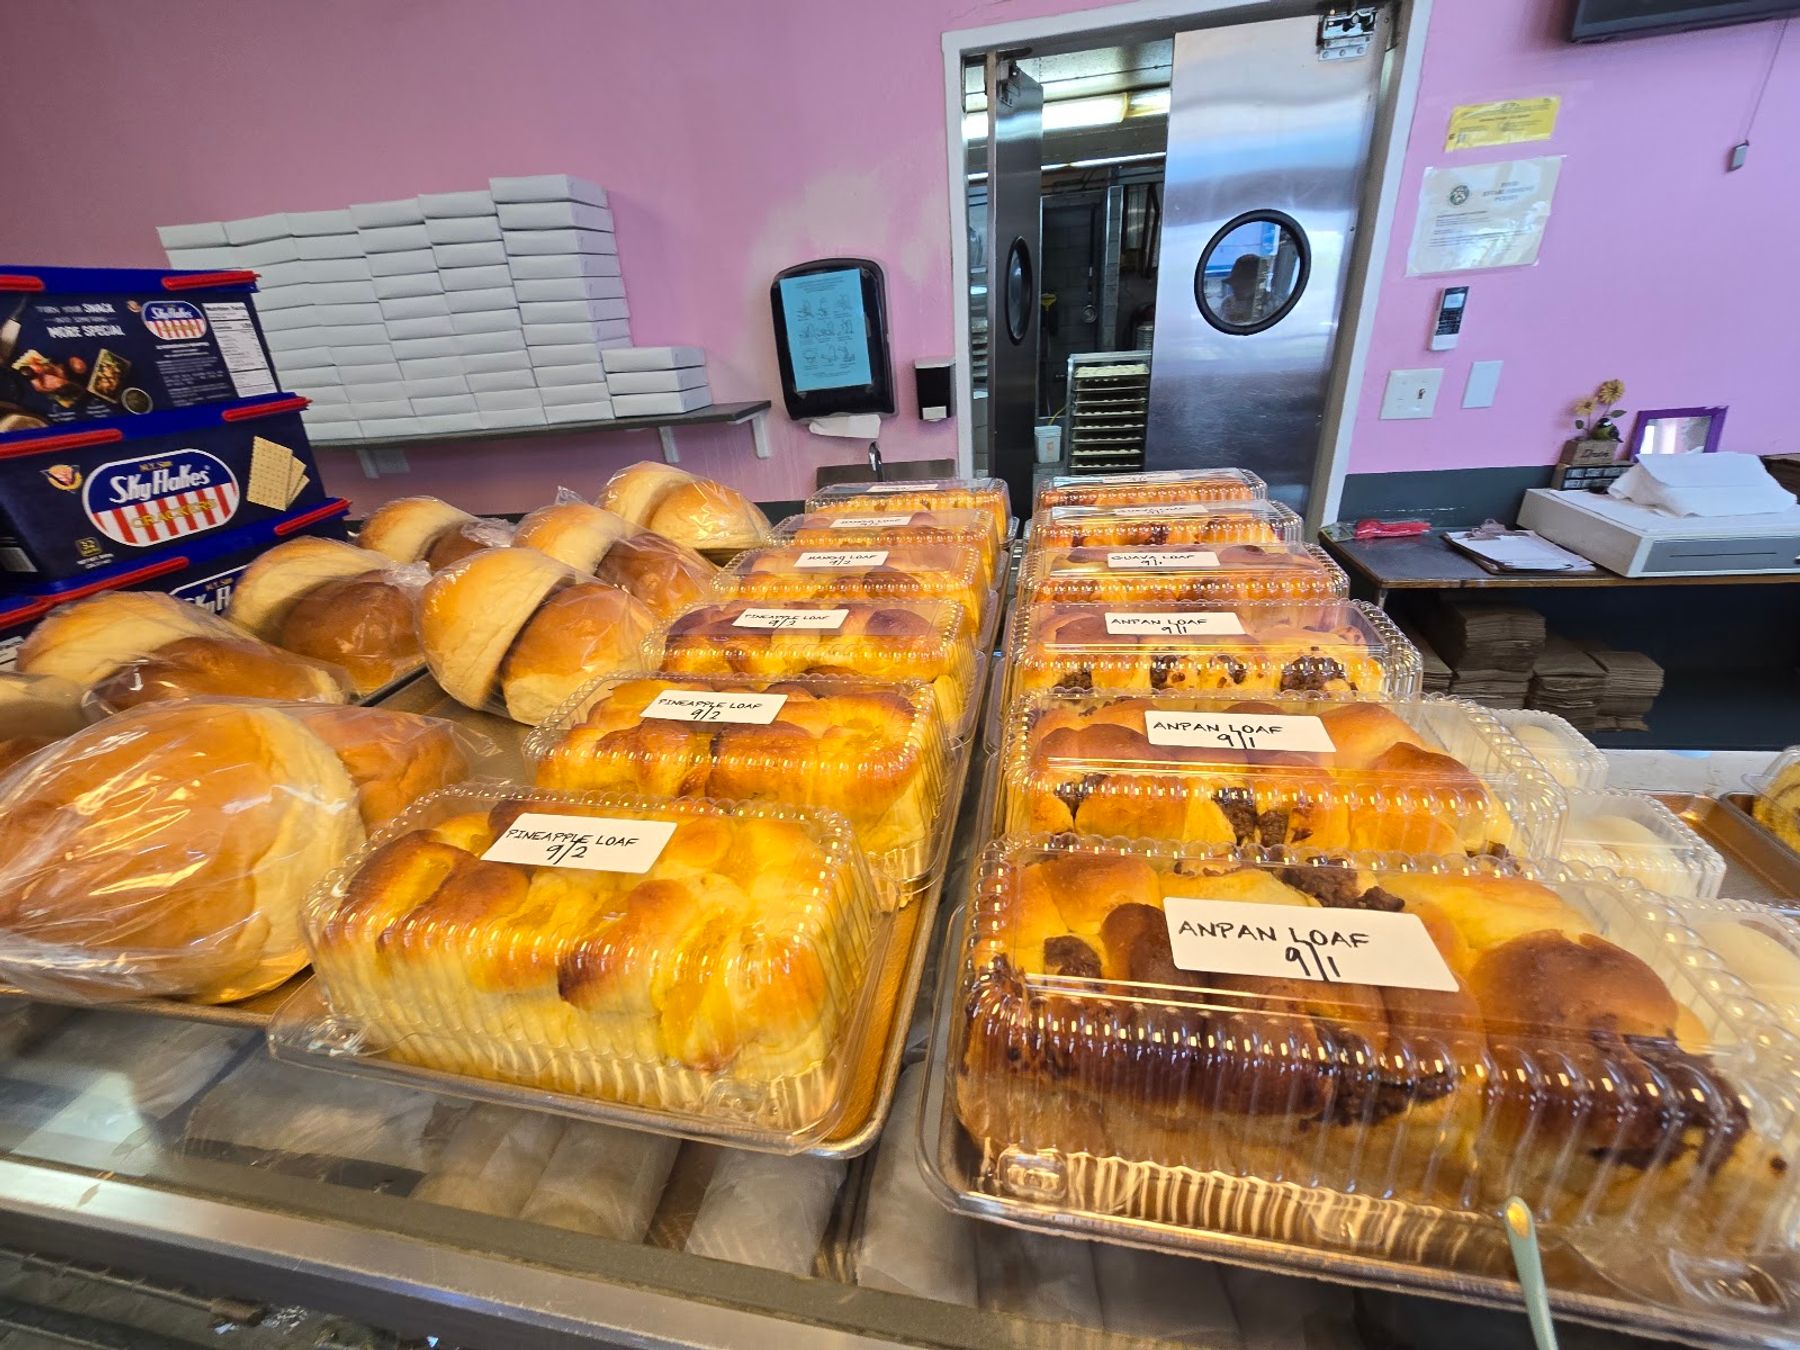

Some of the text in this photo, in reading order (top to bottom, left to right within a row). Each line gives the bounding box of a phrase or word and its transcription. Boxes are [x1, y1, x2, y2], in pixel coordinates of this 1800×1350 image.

[1167, 618, 1208, 626] LOAF
[658, 698, 763, 710] PINEAPPLE LOAF
[690, 706, 721, 720] 9/2
[1152, 722, 1283, 735] ANPAN LOAF
[1217, 732, 1256, 750] 9/1
[506, 828, 640, 848] PINEAPPLE LOAF
[545, 838, 588, 866] 9/2
[1177, 920, 1370, 948] ANPAN LOAF
[1284, 942, 1341, 982] 9/1
